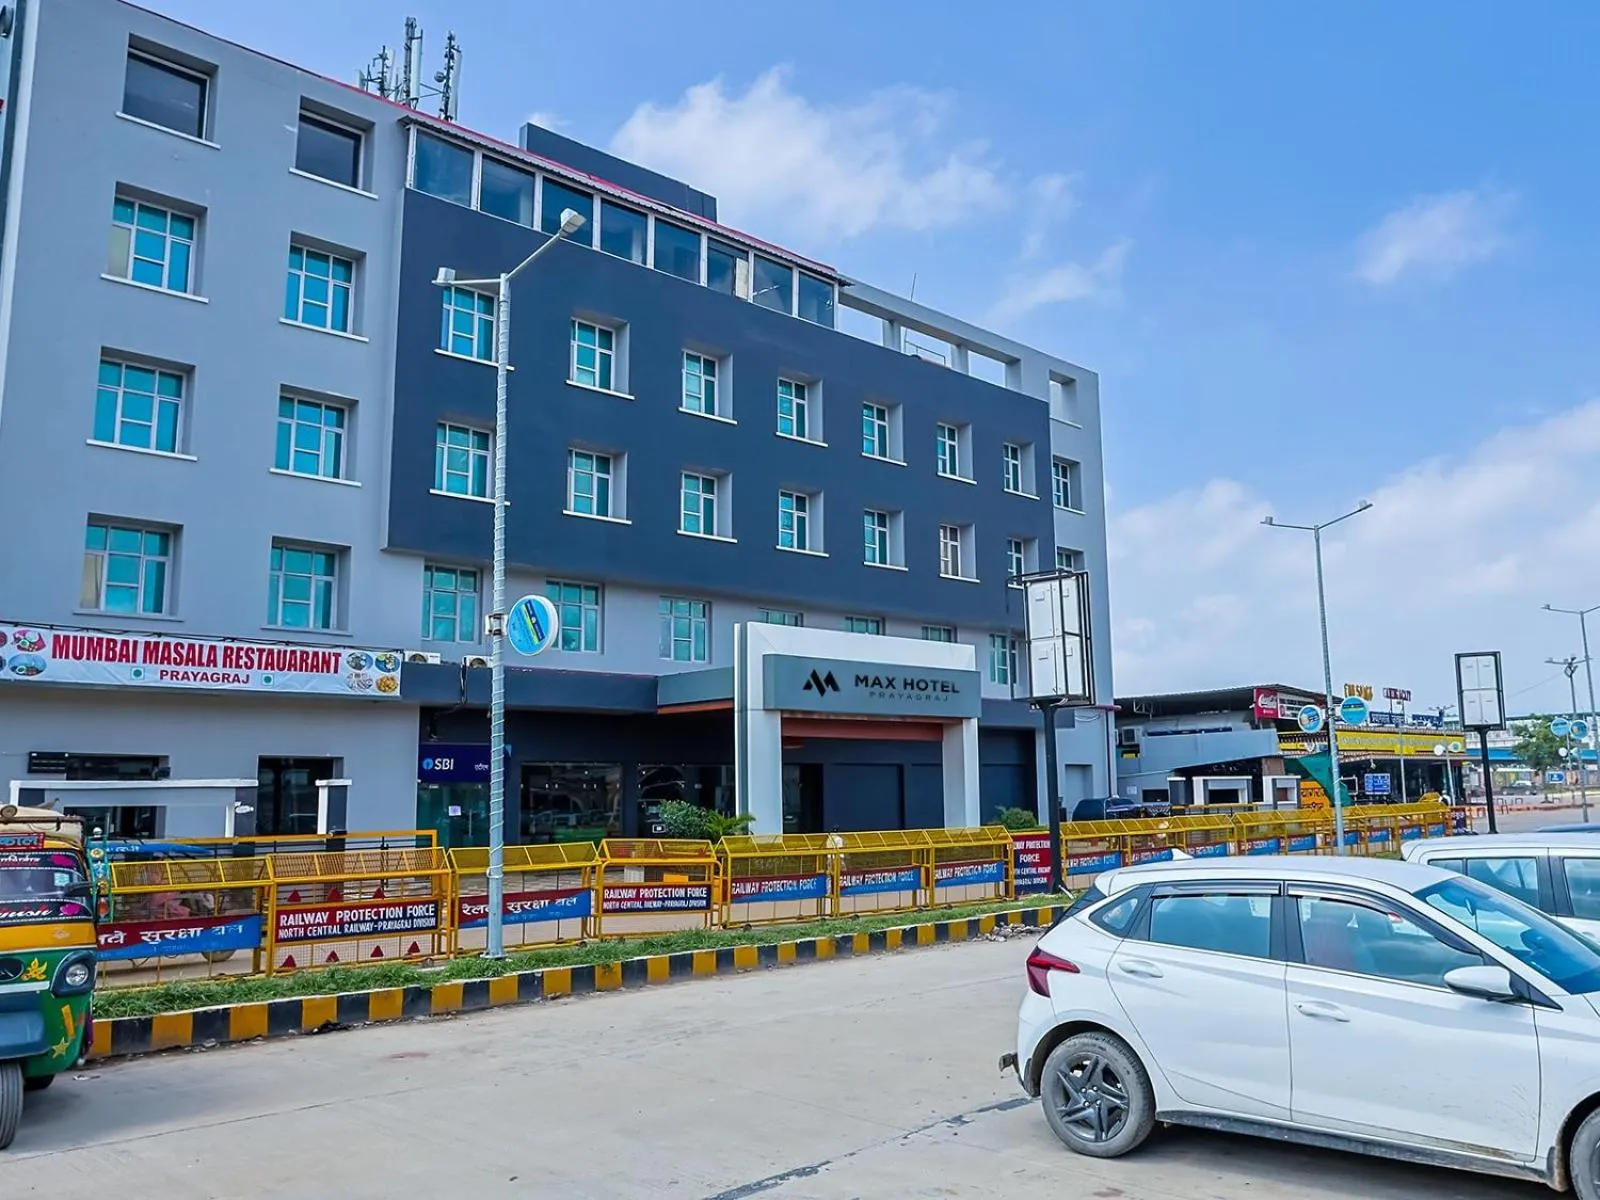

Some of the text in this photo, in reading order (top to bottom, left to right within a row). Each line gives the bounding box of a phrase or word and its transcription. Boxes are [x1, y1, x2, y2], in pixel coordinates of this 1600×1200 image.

[52, 634, 342, 674] MUMBAI MASALA RESTAUARANT
[160, 669, 250, 685] PRAYAGRAJ
[855, 674, 960, 693] MAX HOTEL
[869, 691, 948, 702] PRAYAGRAJ
[434, 758, 454, 770] SBI
[1019, 853, 1040, 863] FORCE
[604, 887, 707, 899] RAILWAY PROTECTION FORCE
[731, 878, 817, 895] RAILWAY PROTECTION FORCE
[280, 904, 435, 926] RAILWAY PROTECTION FORCE
[139, 927, 204, 944] सुरक्षा
[278, 927, 304, 939] NORTH
[307, 924, 342, 937] CENTRAL
[413, 917, 436, 928] DIVISION
